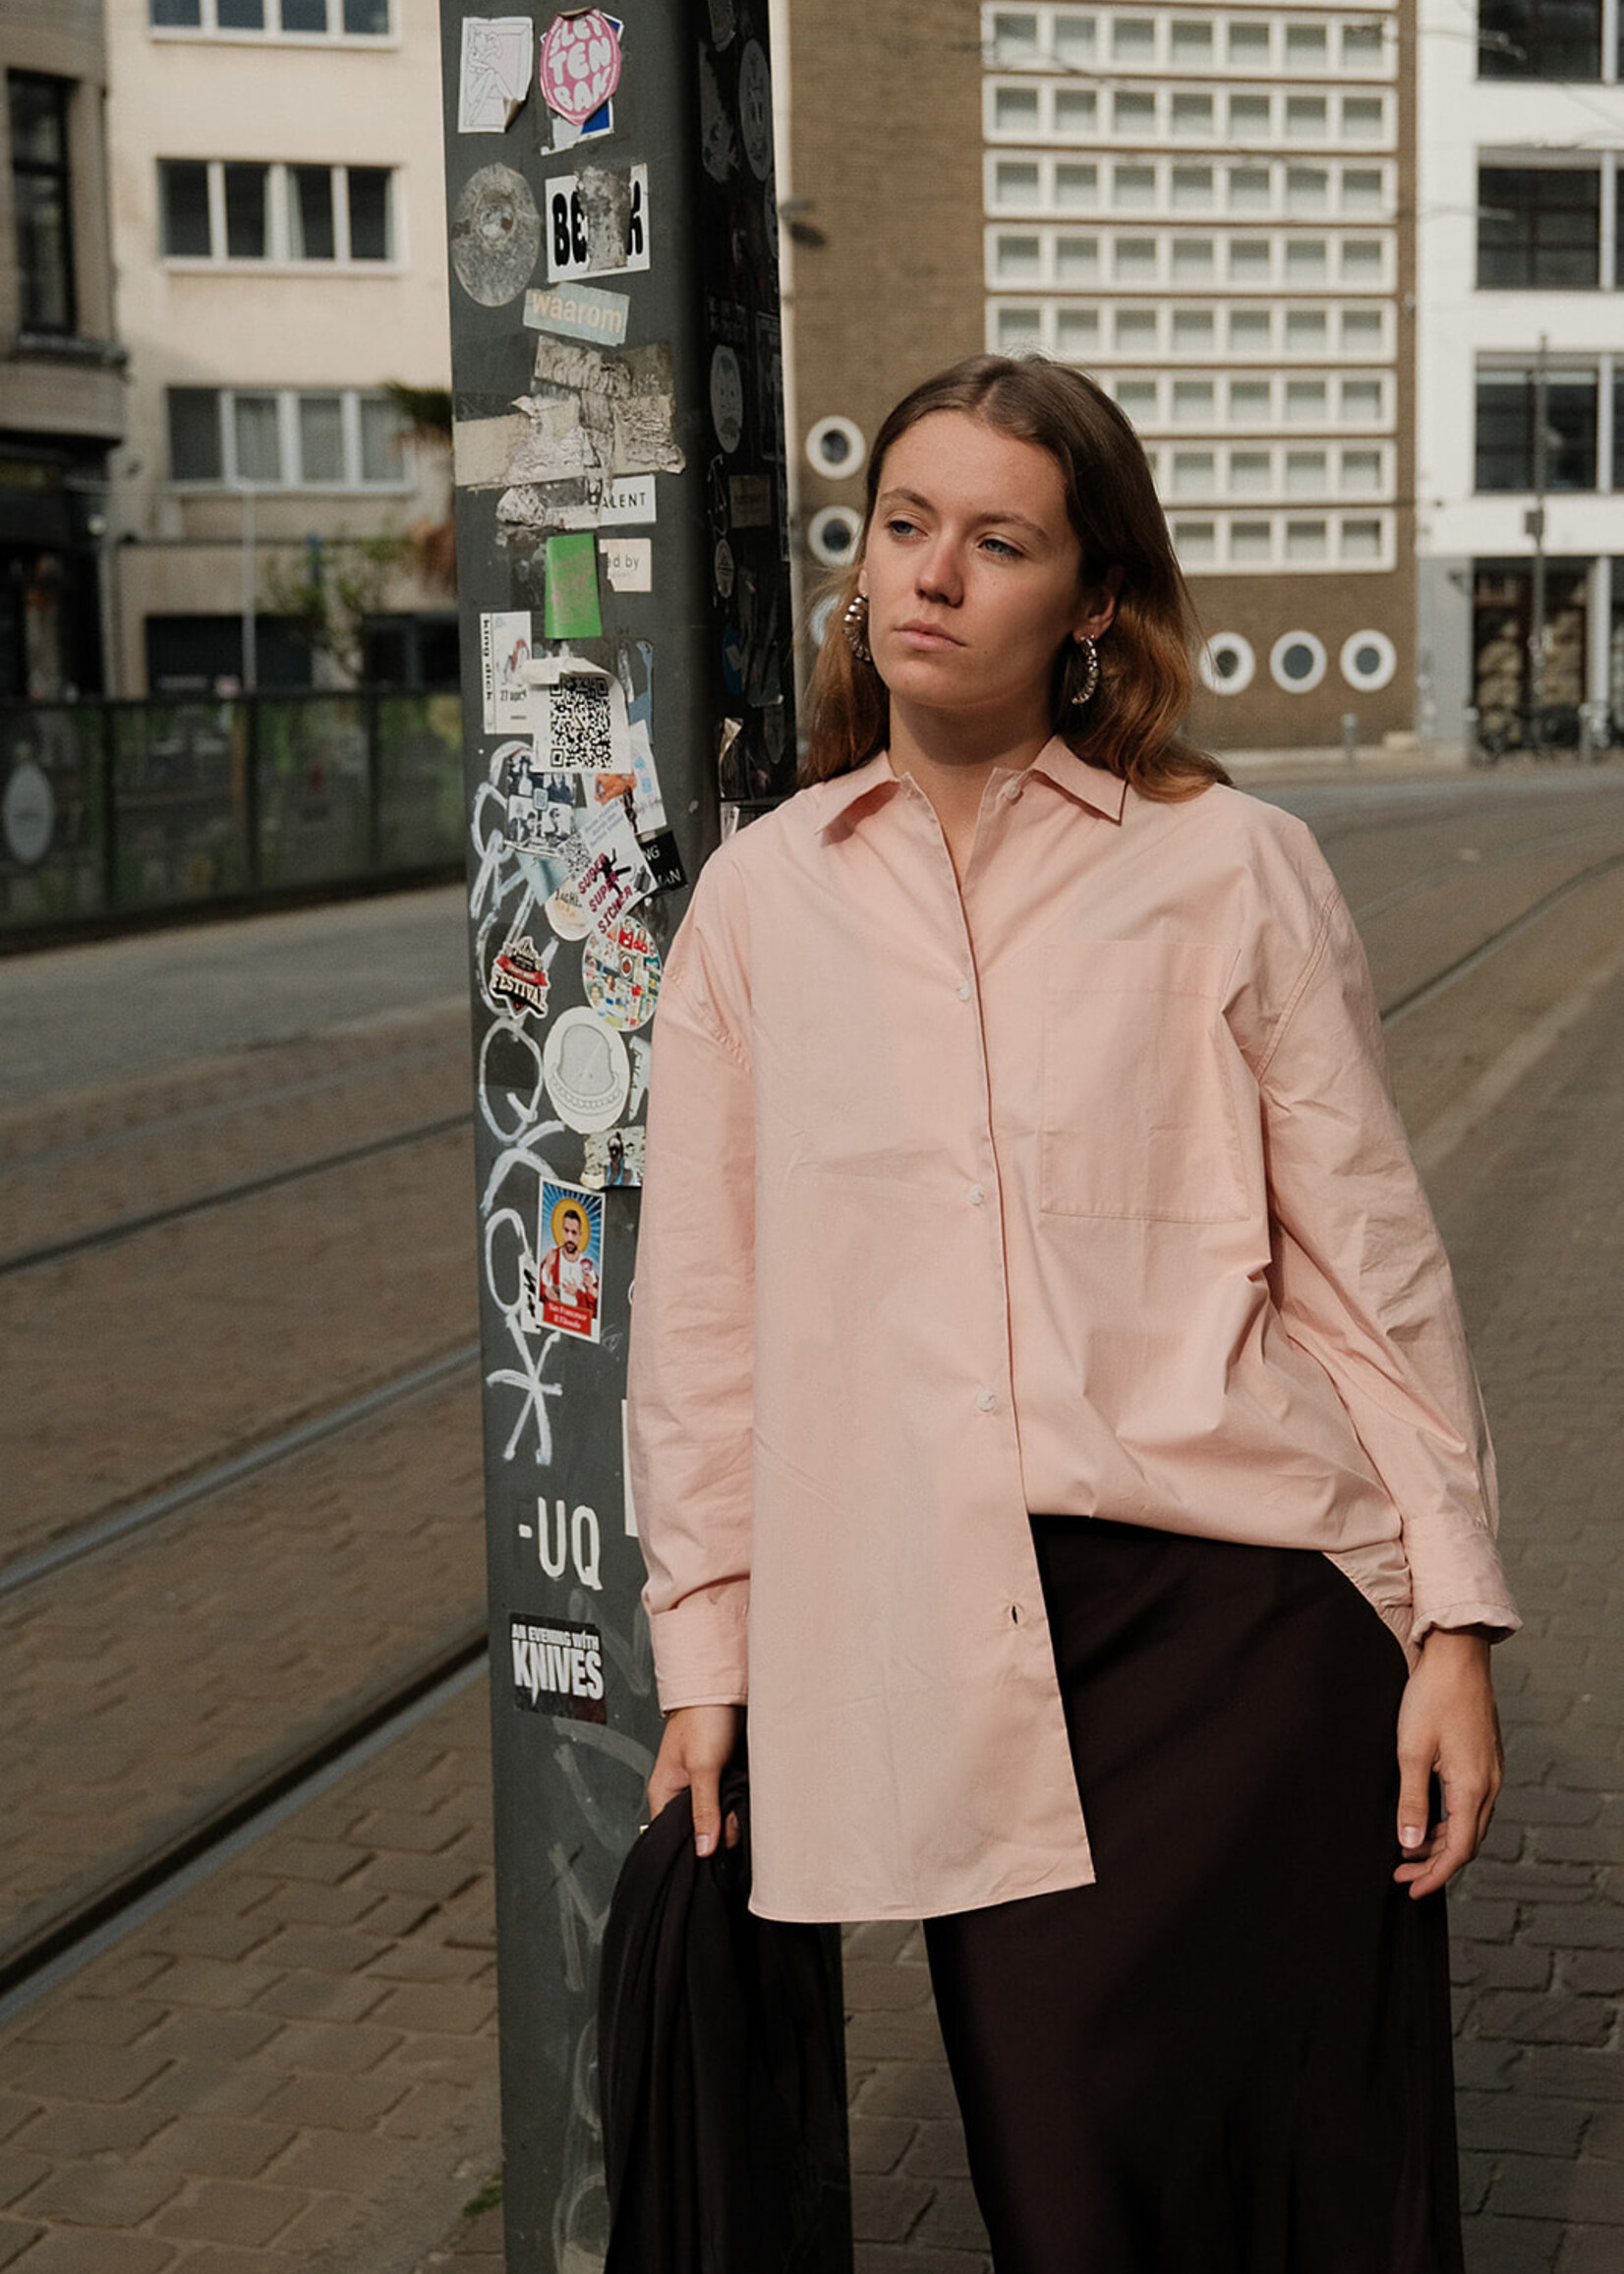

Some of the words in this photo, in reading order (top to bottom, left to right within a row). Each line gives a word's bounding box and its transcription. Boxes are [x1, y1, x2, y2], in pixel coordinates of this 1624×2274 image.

[549, 15, 603, 57] SLET
[548, 36, 611, 85] TEN
[552, 66, 611, 113] BAK
[532, 292, 622, 334] waarom
[624, 555, 641, 571] by
[587, 870, 619, 913] SUPER
[493, 969, 547, 1012] FESTIVAL
[511, 1622, 527, 1639] AN
[527, 1626, 571, 1647] EVENING
[570, 1629, 600, 1651] WITH
[511, 1639, 605, 1707] KNIVES
